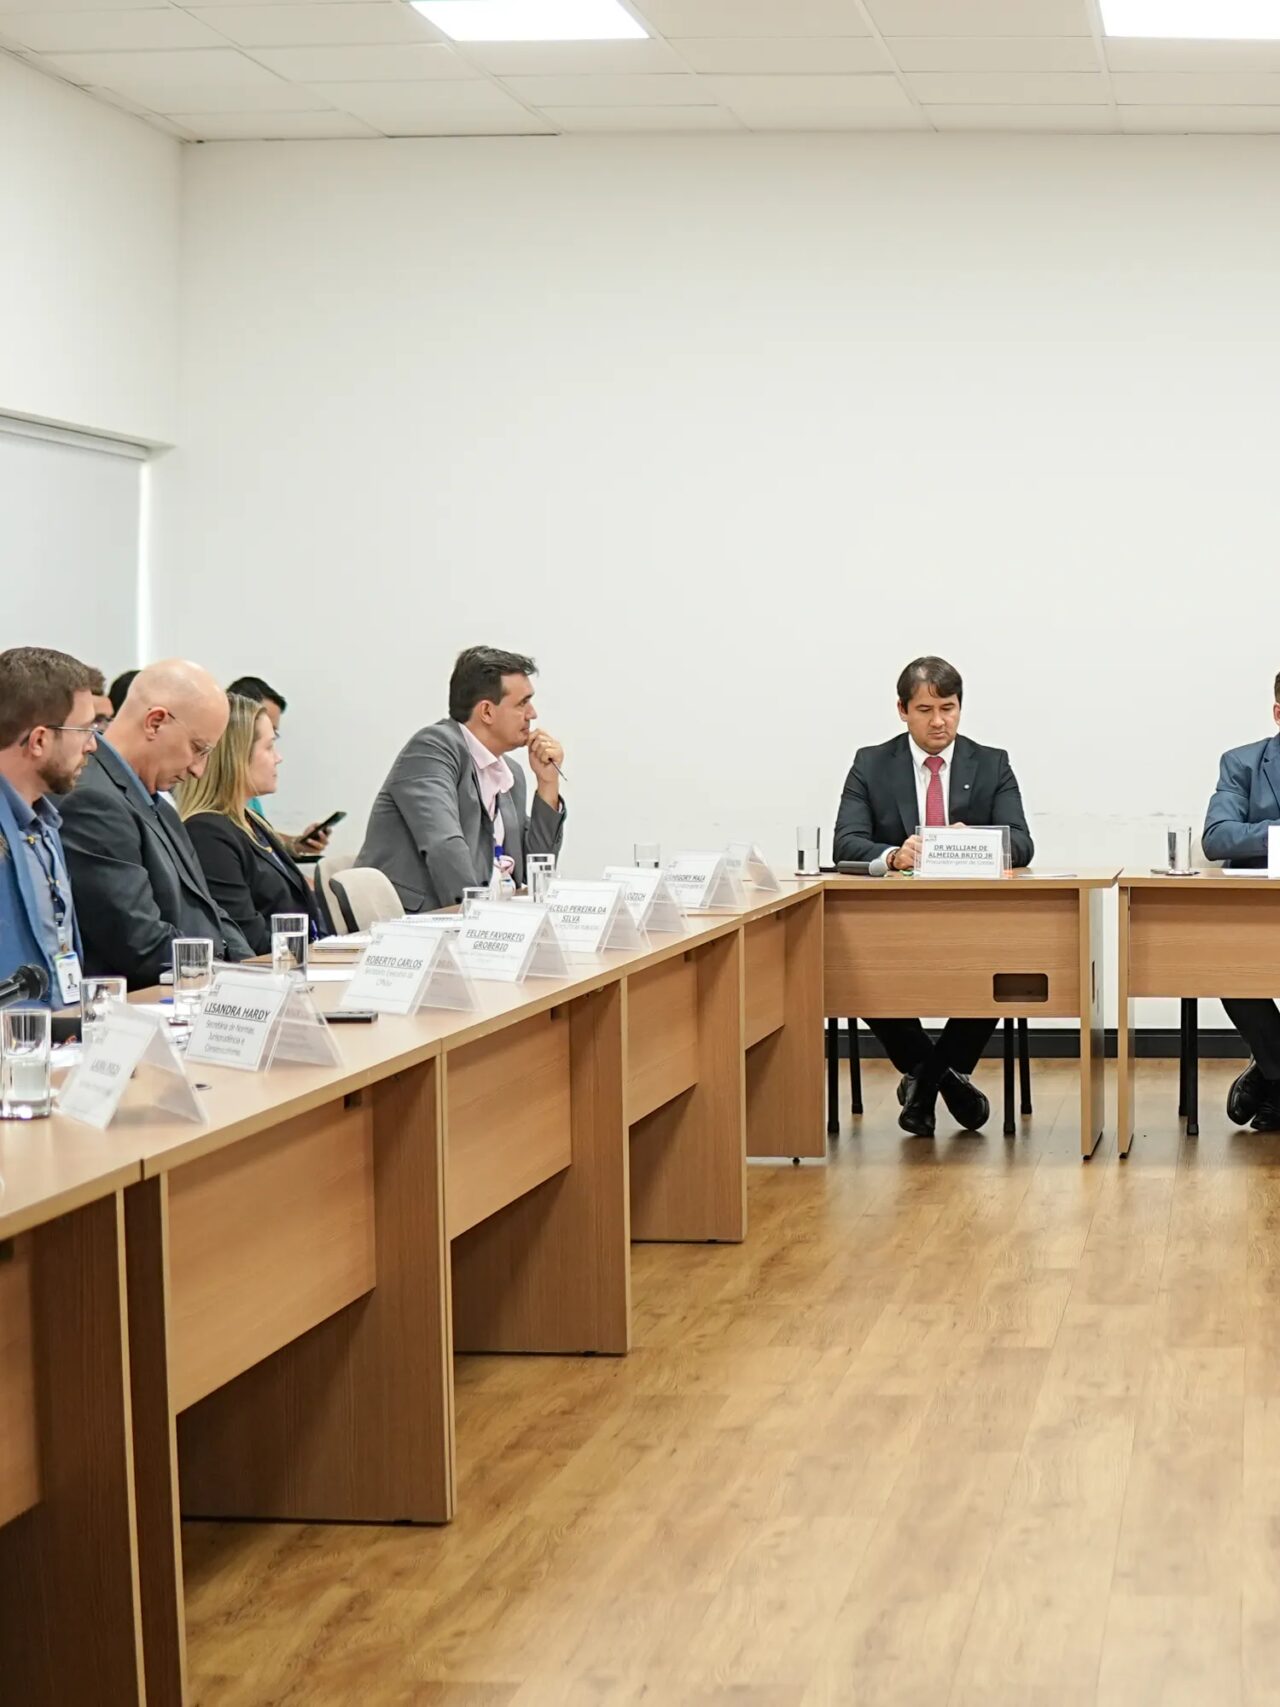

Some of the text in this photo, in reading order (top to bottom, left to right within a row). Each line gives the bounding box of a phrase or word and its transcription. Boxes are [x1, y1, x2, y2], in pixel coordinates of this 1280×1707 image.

[569, 906, 596, 914] PEREIRA
[561, 914, 580, 923] SILVA
[466, 929, 525, 942] FELIPE FAVORETO
[365, 955, 424, 970] ROBERTO CARLOS
[204, 1002, 271, 1022] LISANDRA HARDY
